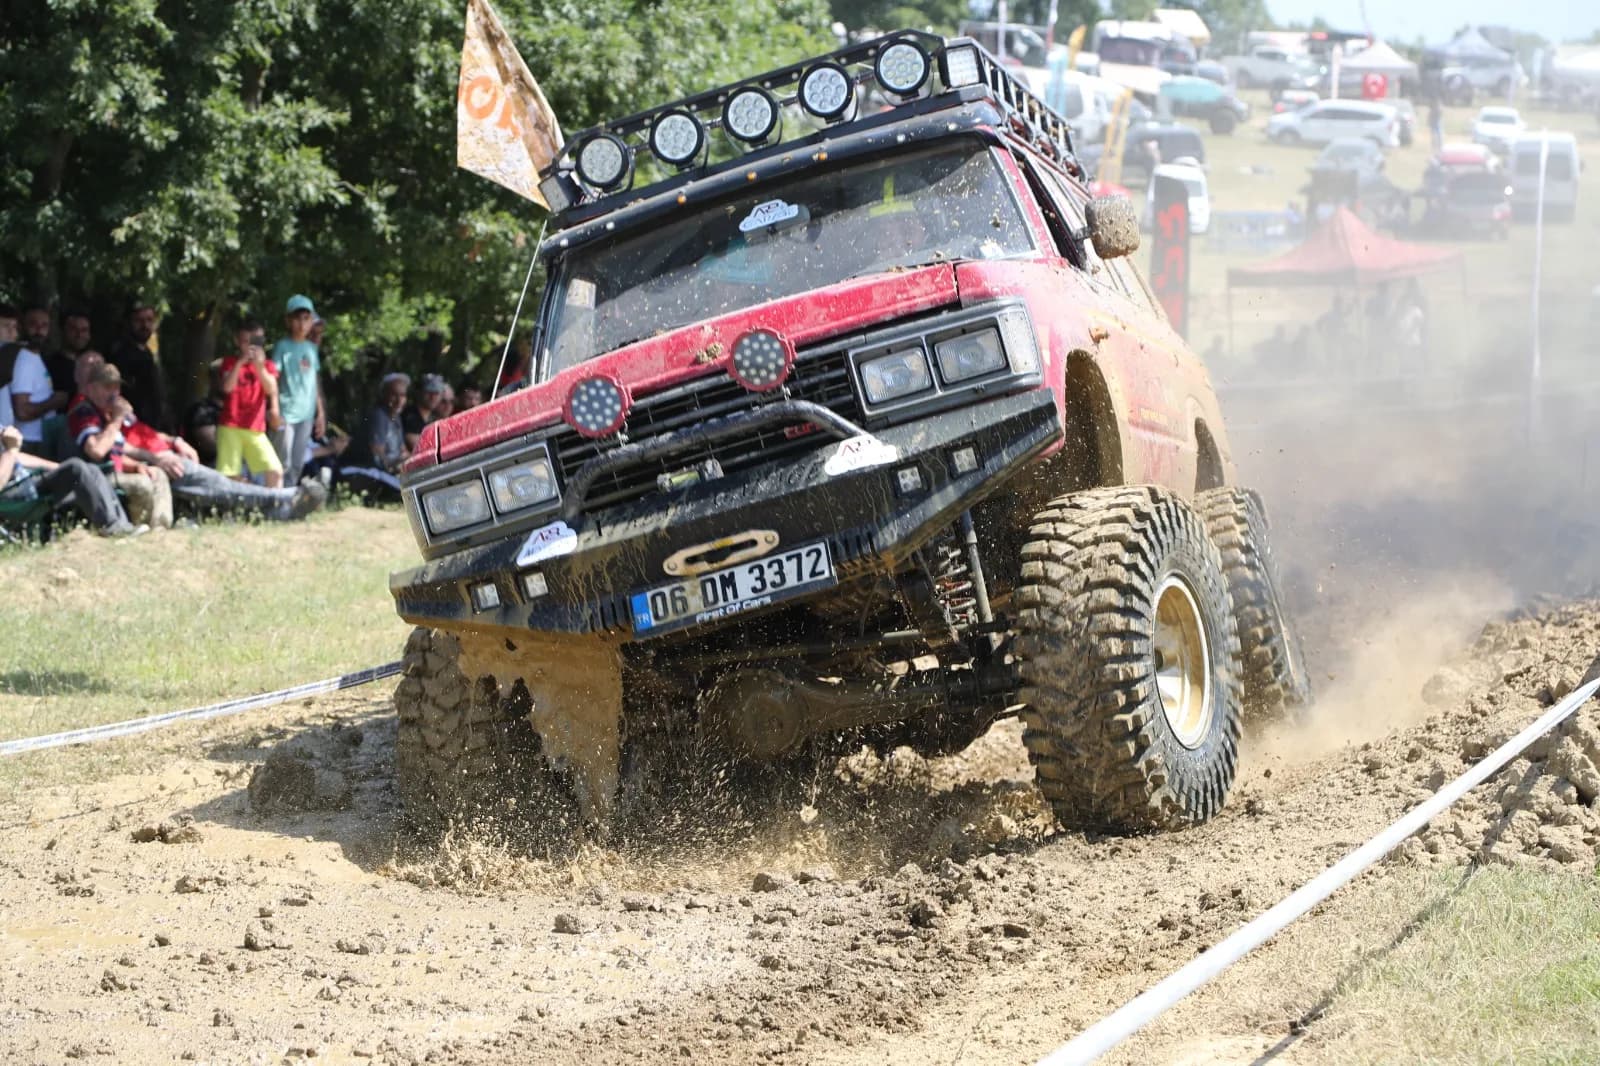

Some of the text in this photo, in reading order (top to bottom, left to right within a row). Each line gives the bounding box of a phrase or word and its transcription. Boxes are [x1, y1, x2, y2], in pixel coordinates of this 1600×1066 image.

[650, 547, 826, 622] 06 DM 3372
[636, 613, 650, 625] TR
